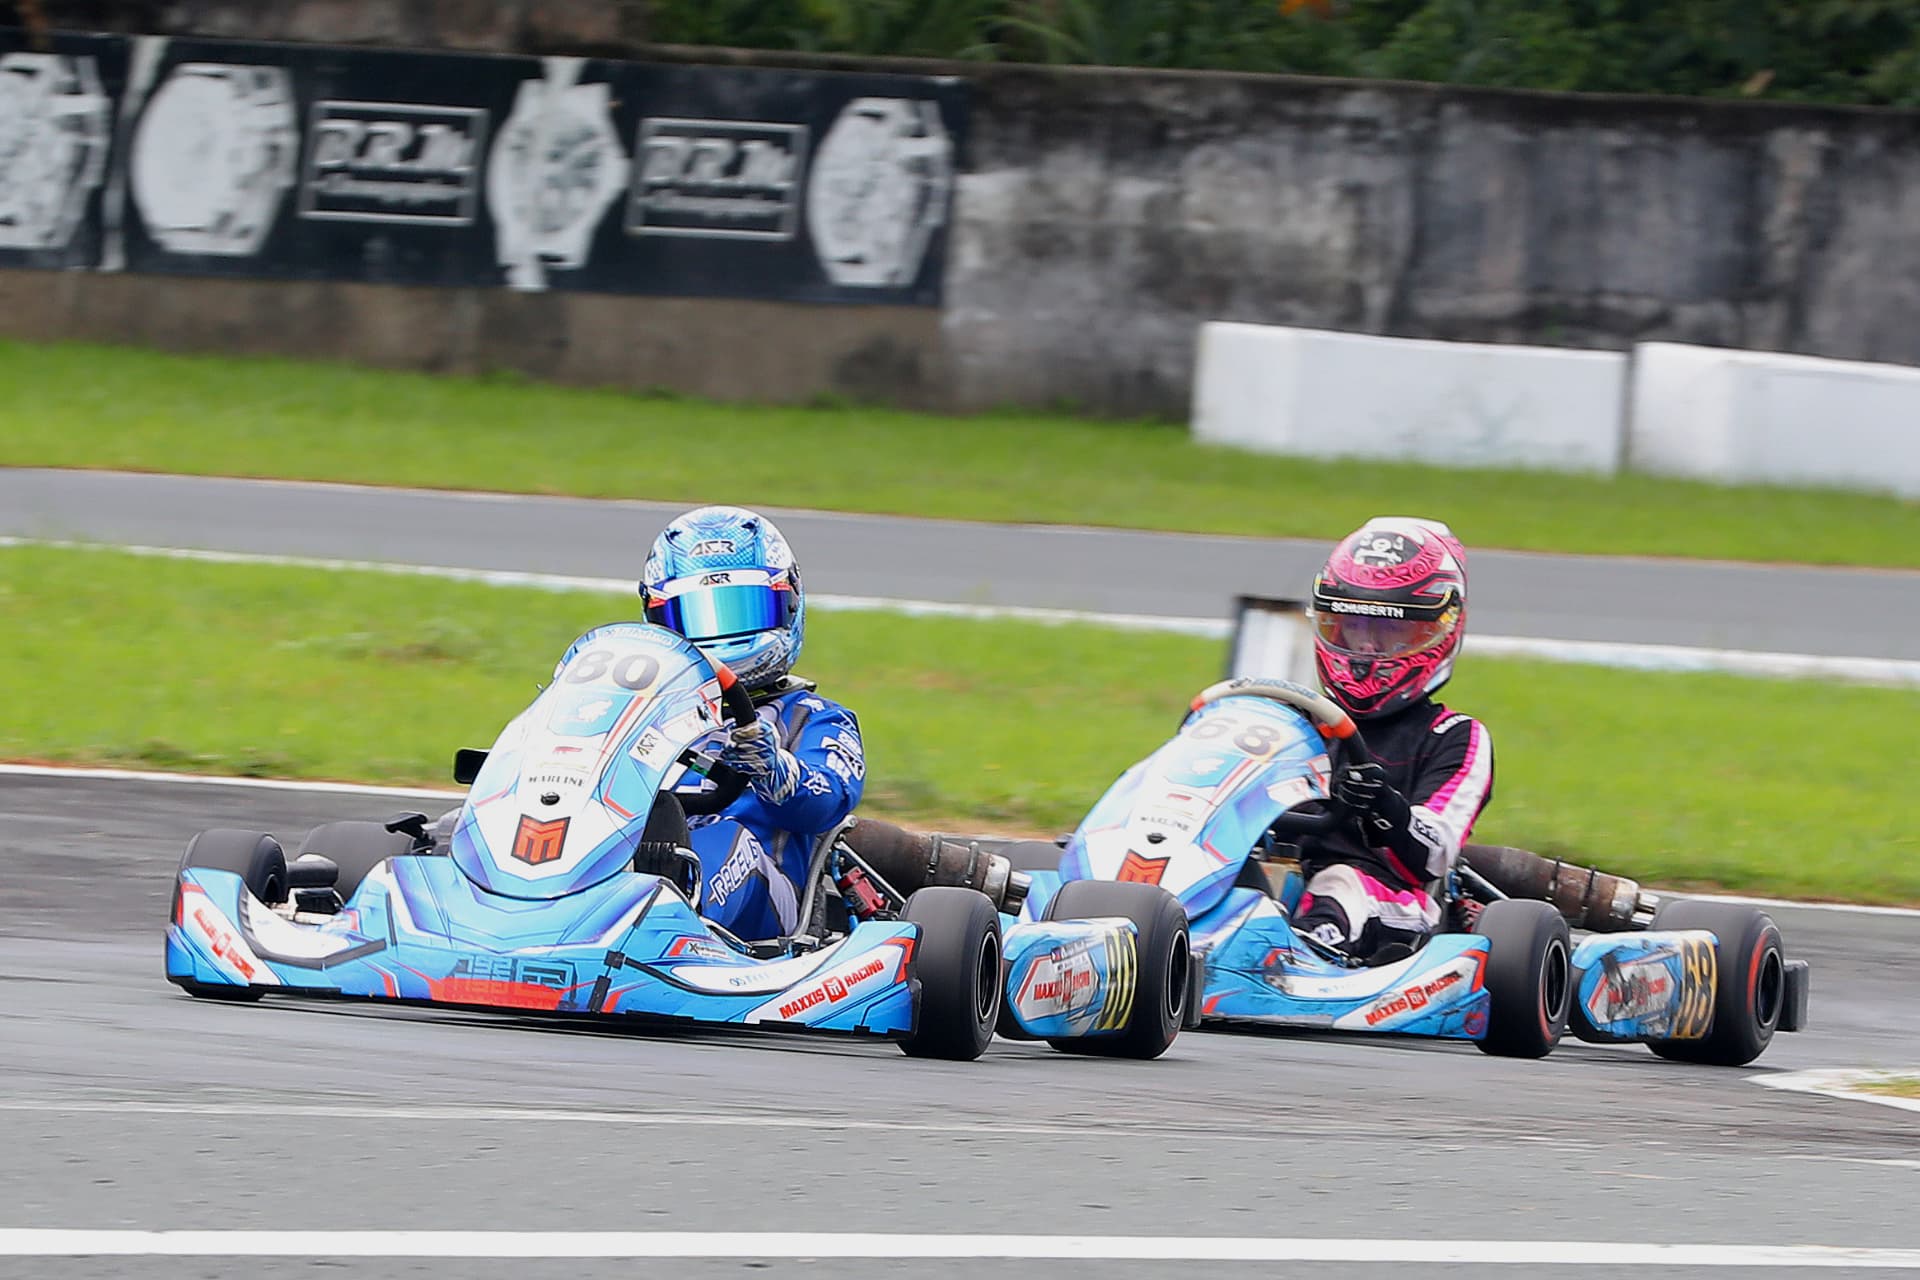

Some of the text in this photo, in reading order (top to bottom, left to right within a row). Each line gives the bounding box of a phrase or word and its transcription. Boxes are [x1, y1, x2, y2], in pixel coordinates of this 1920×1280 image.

[1331, 600, 1405, 619] SCHUBERTH
[566, 650, 660, 691] 80
[1190, 717, 1281, 756] 68
[779, 988, 826, 1020] MAXXIS
[844, 959, 884, 988] RACING
